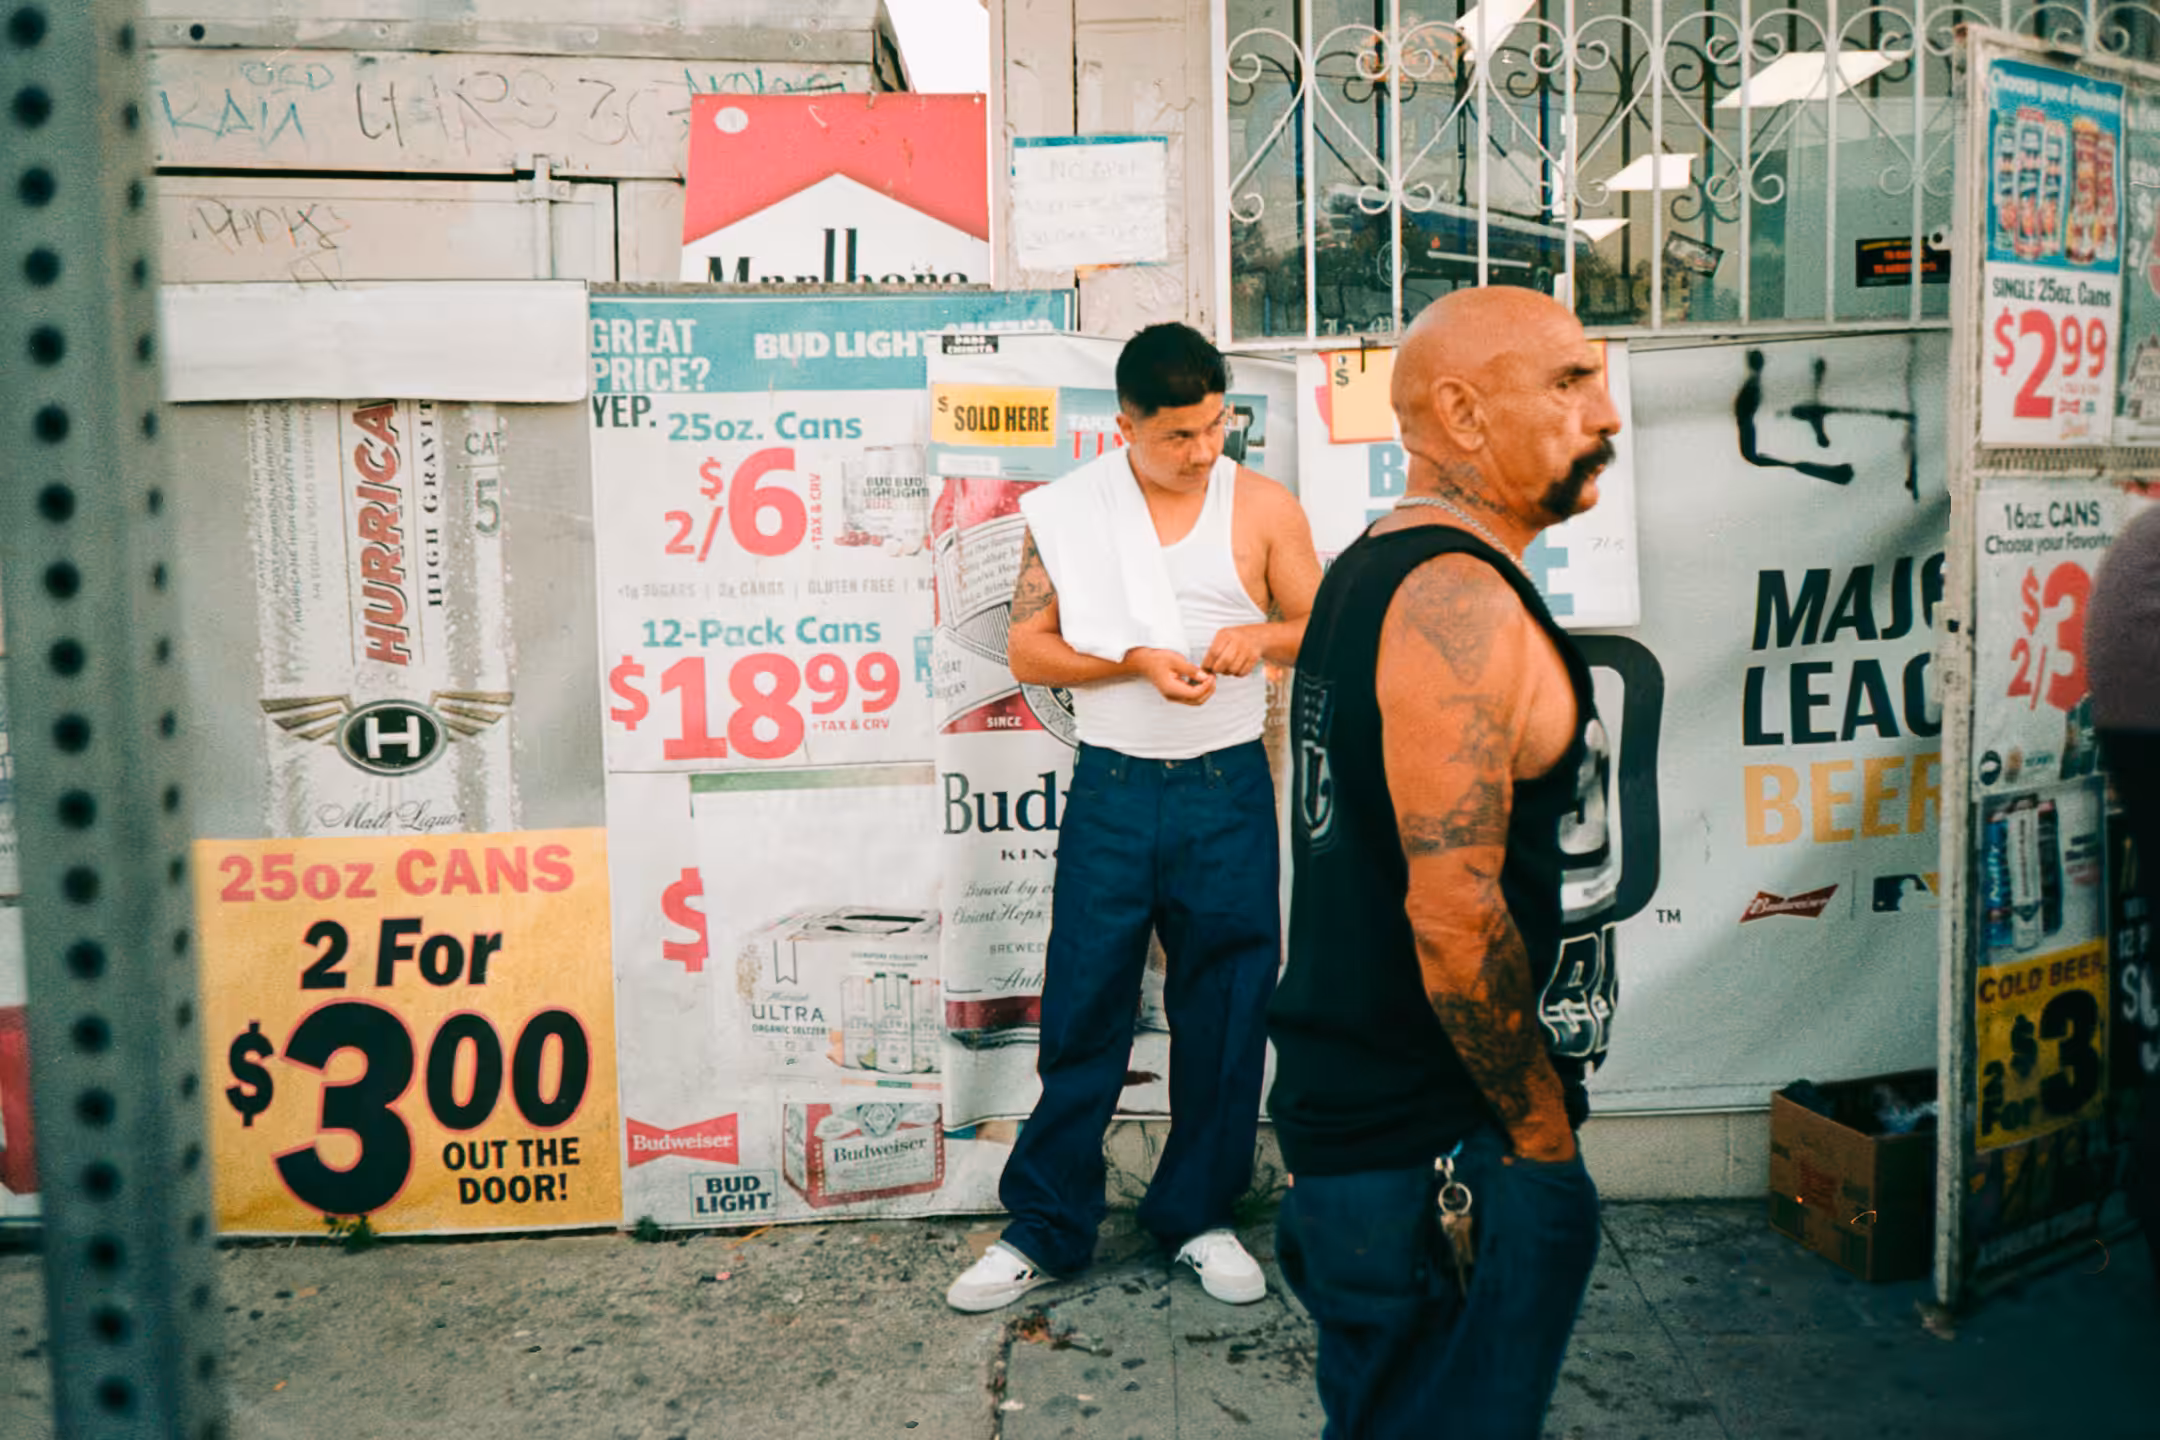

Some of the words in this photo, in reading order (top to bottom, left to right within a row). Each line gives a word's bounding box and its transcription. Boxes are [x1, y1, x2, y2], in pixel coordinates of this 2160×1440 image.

[1992, 277, 2036, 301] SINGLE
[2078, 281, 2112, 307] Cans
[590, 318, 698, 355] GREAT
[755, 331, 831, 360] BUD
[590, 357, 711, 393] PRICE?
[592, 394, 657, 428] YEP.
[954, 405, 1001, 433] SOLD
[1004, 405, 1050, 432] HERE
[667, 412, 765, 442] 25oz.
[775, 411, 863, 441] Cans
[2049, 500, 2101, 528] CANS
[808, 578, 858, 595] GLUTEN
[862, 577, 895, 593] FREE
[642, 616, 786, 648] 12-Pack
[795, 616, 882, 645] Cans
[363, 715, 421, 759] H
[986, 715, 1022, 729] SINCE
[316, 800, 392, 830] Malt
[941, 770, 1070, 835] Bud
[1001, 848, 1058, 861] KIN
[218, 852, 378, 904] 25oz
[396, 844, 575, 897] CANS
[660, 866, 709, 974] $
[1656, 909, 1682, 924] TM
[299, 918, 350, 990] 2
[375, 916, 503, 987] For
[1978, 967, 2044, 1005] COLD
[752, 1003, 825, 1023] ULTRA
[442, 1140, 508, 1172] OUT
[516, 1137, 582, 1168] THE
[632, 1132, 735, 1152] Budweiser
[833, 1135, 928, 1164] Budweiser
[457, 1172, 569, 1205] DOOR!
[705, 1176, 761, 1194] BUD
[695, 1192, 772, 1214] LIGHT
